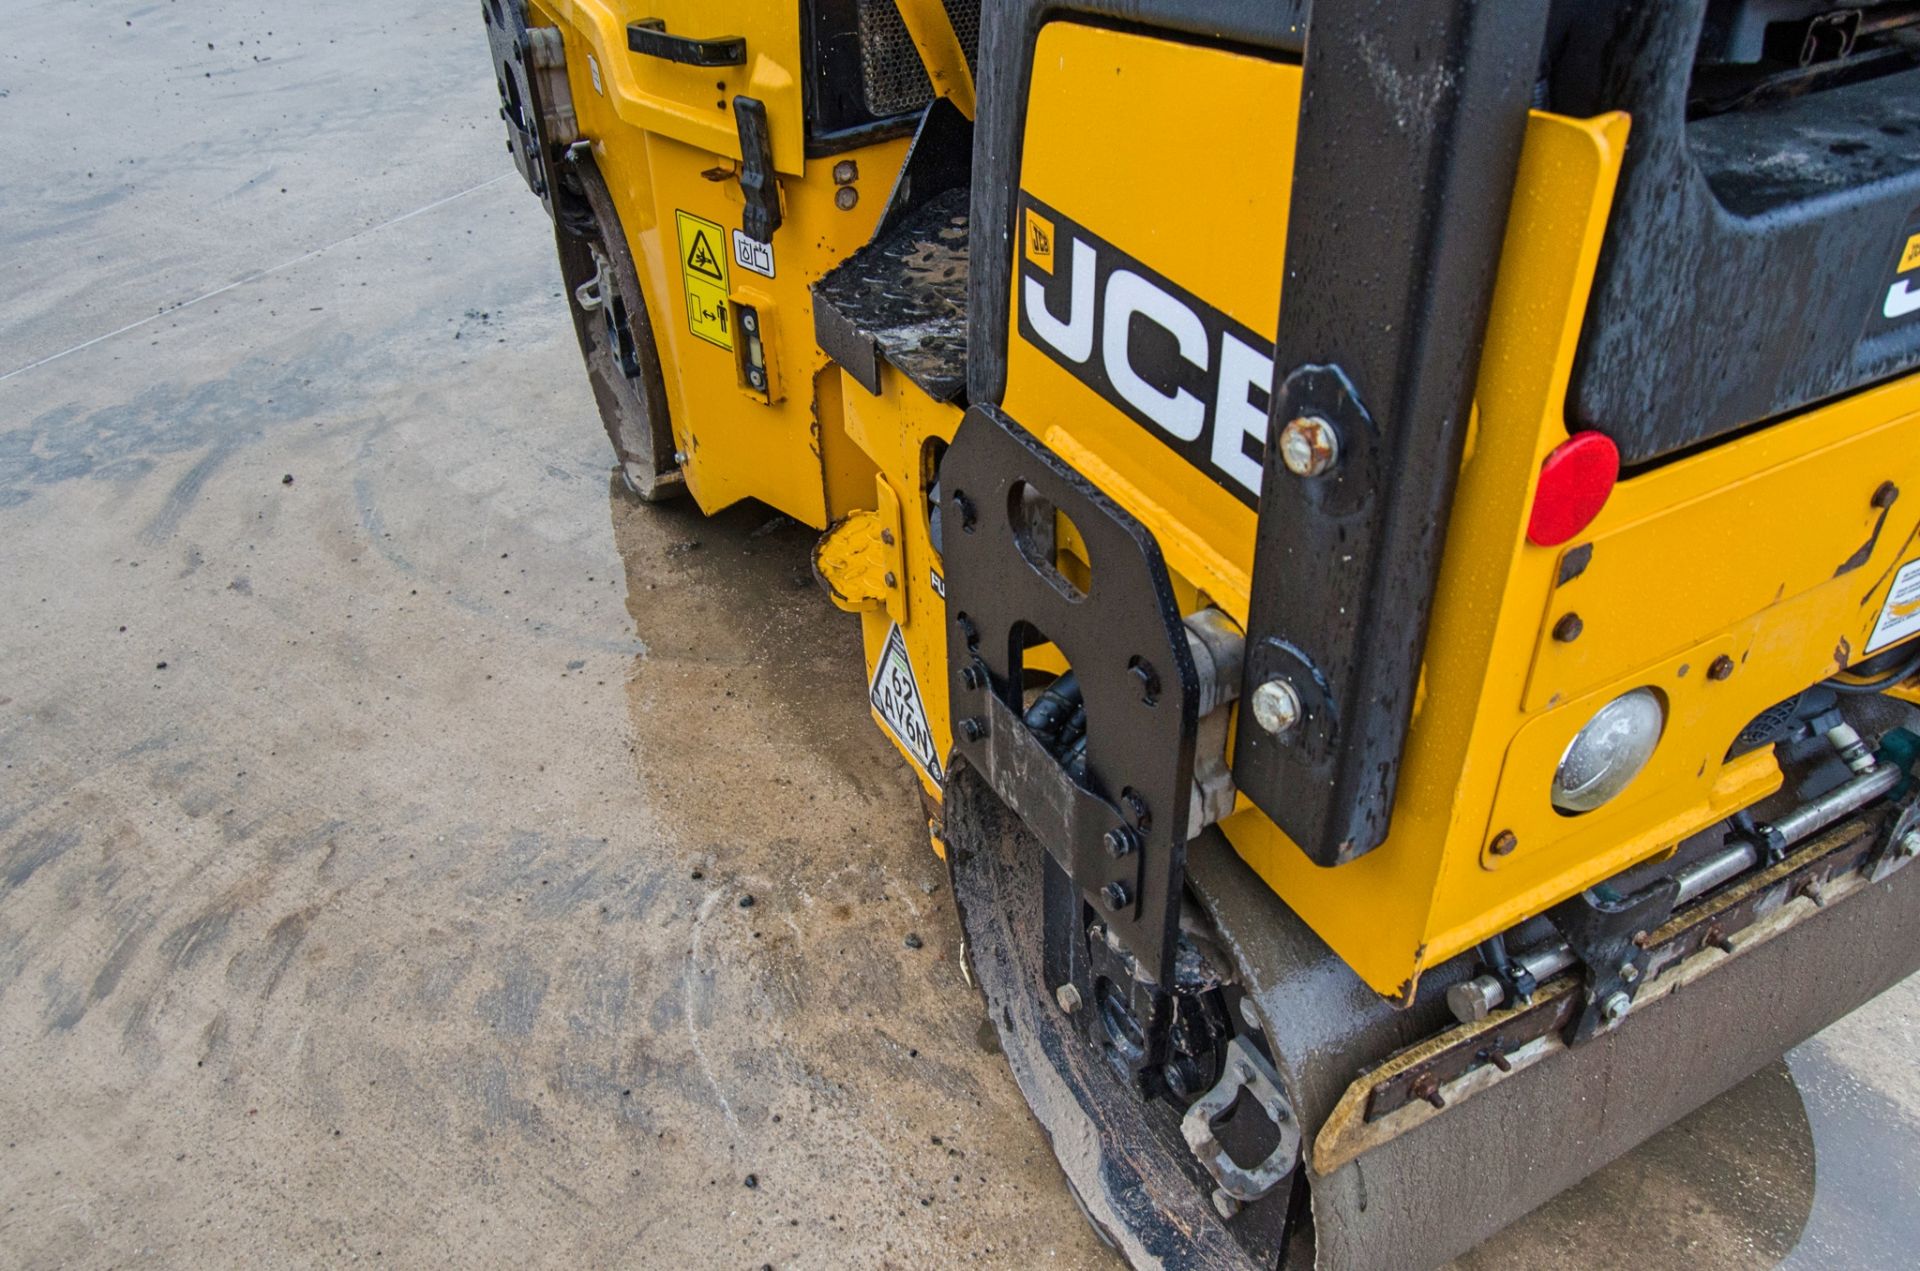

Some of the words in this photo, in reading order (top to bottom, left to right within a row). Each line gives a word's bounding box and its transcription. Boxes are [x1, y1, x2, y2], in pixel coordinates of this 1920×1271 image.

[1032, 223, 1050, 254] JCB
[892, 667, 915, 714] 62
[884, 685, 929, 760] AY6N
